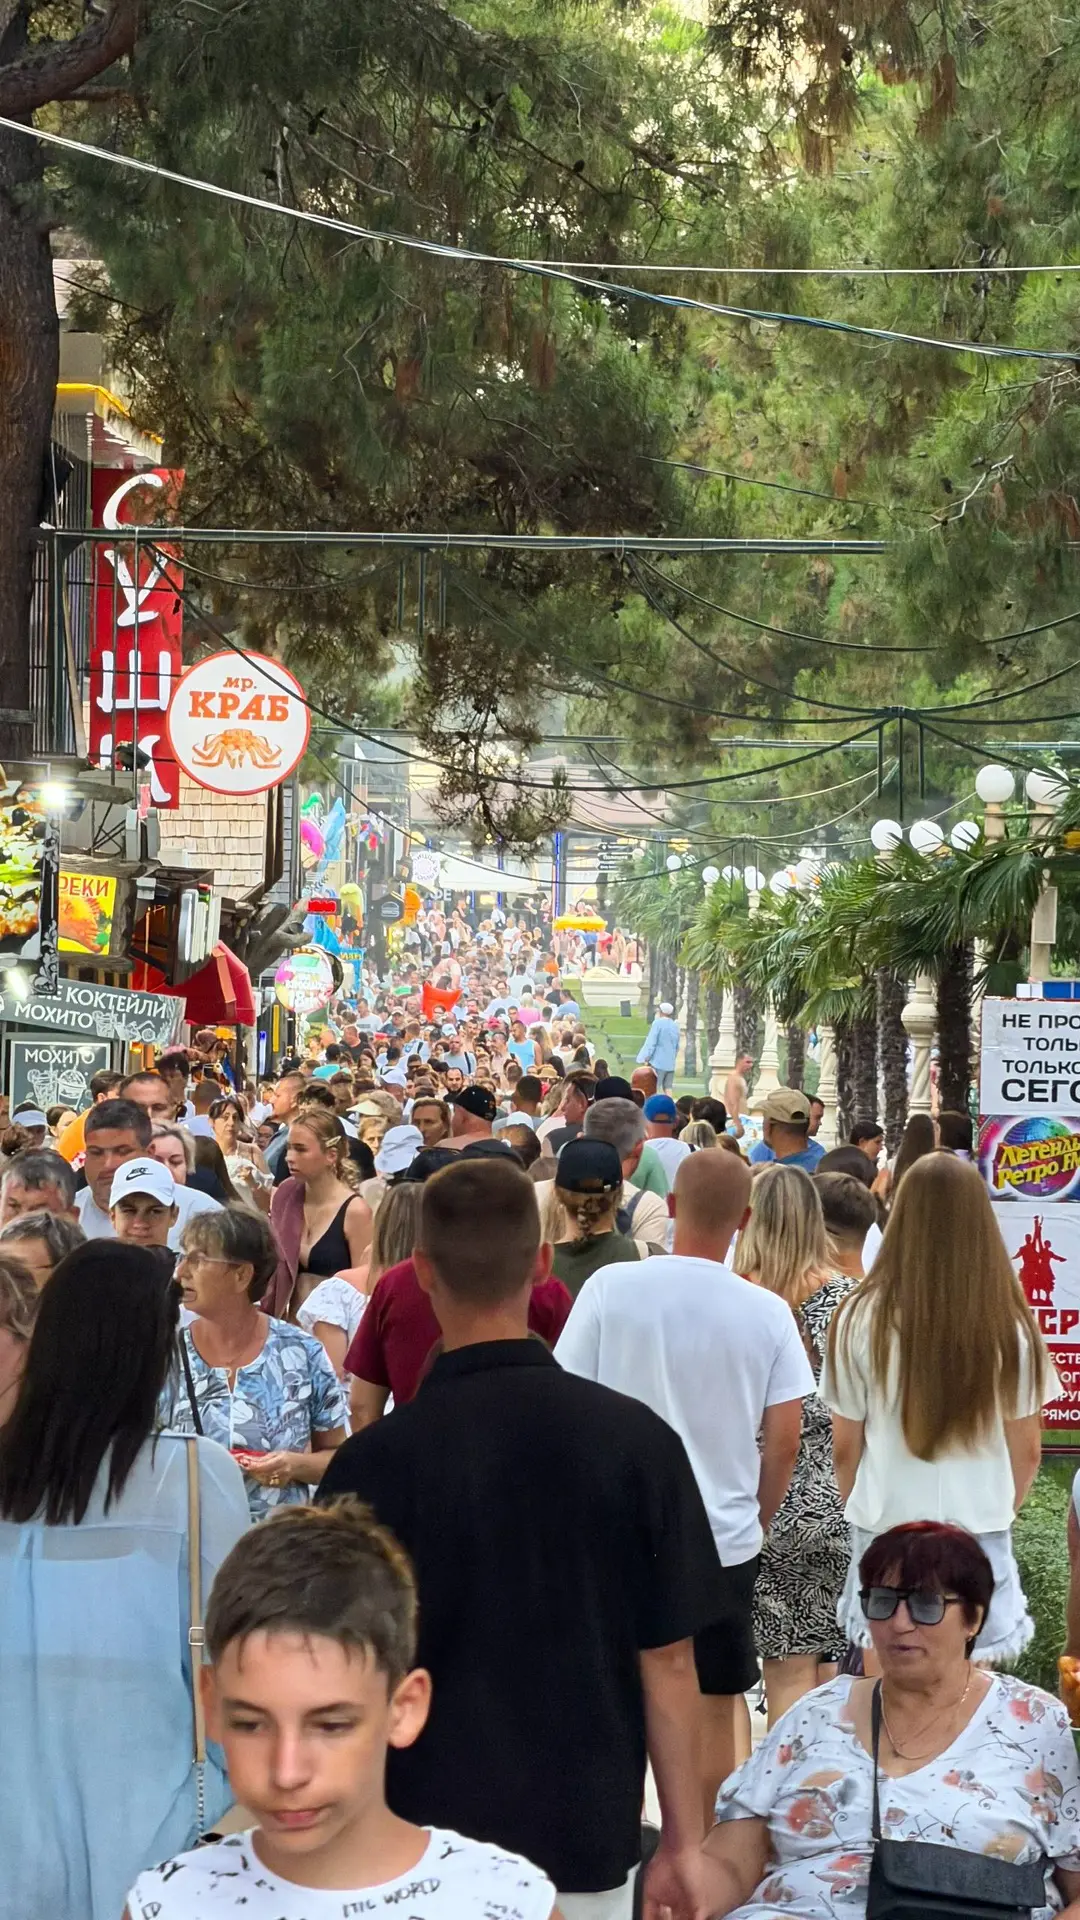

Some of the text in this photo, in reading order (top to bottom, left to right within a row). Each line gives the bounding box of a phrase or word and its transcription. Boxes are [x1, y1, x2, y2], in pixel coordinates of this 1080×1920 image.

[187, 691, 289, 722] КРАБ
[14, 1001, 94, 1029] МОХИТО
[66, 987, 167, 1019] КОКТЕЙЛИ
[1002, 1013, 1080, 1030] НЕ ПРО
[24, 1048, 95, 1064] МОХИТО
[1022, 1037, 1080, 1052] ТОЛЬ
[1032, 1309, 1080, 1335] СР
